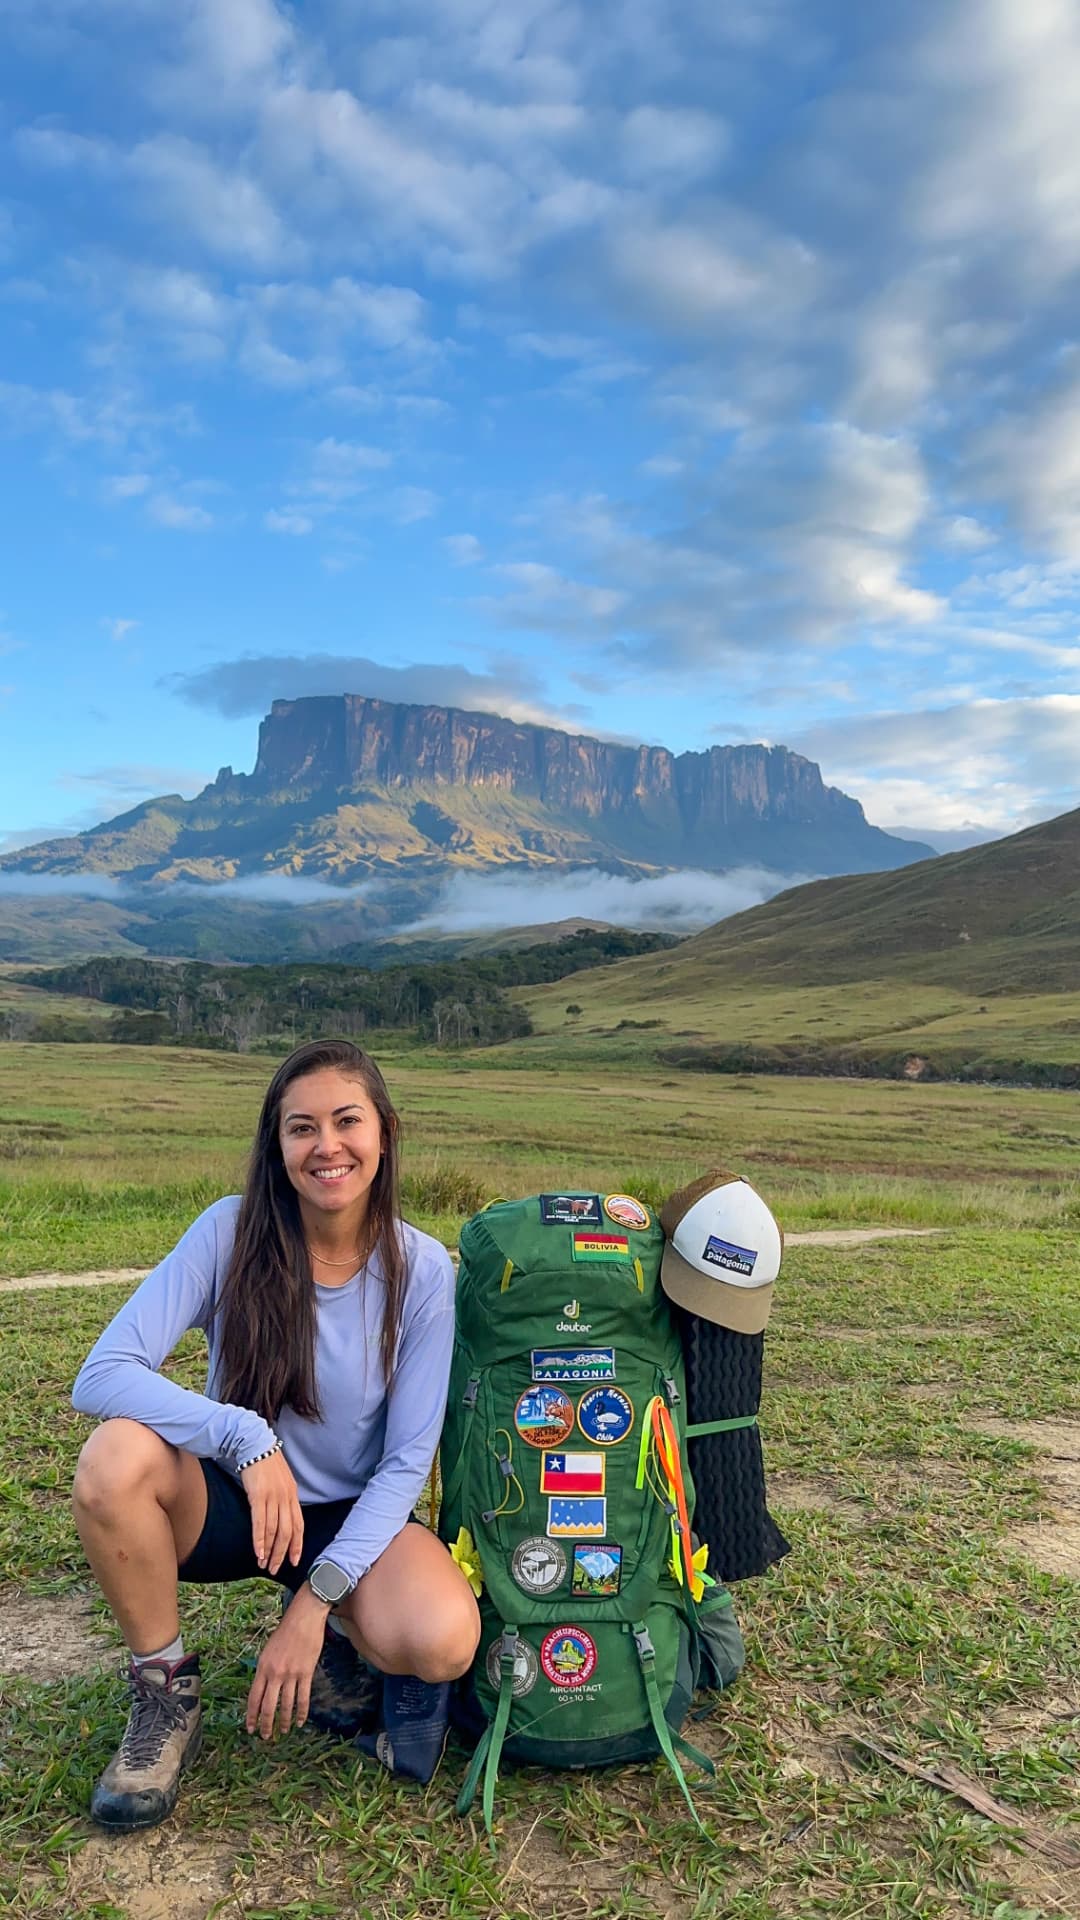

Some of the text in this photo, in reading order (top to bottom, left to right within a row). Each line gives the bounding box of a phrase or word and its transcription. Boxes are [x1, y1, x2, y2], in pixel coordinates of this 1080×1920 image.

[584, 1243, 619, 1251] BOLIVIA
[706, 1251, 751, 1273] patagonia
[556, 1321, 592, 1333] deuter
[535, 1370, 613, 1379] PATAGONIA
[550, 1683, 602, 1694] AIRCONTACT
